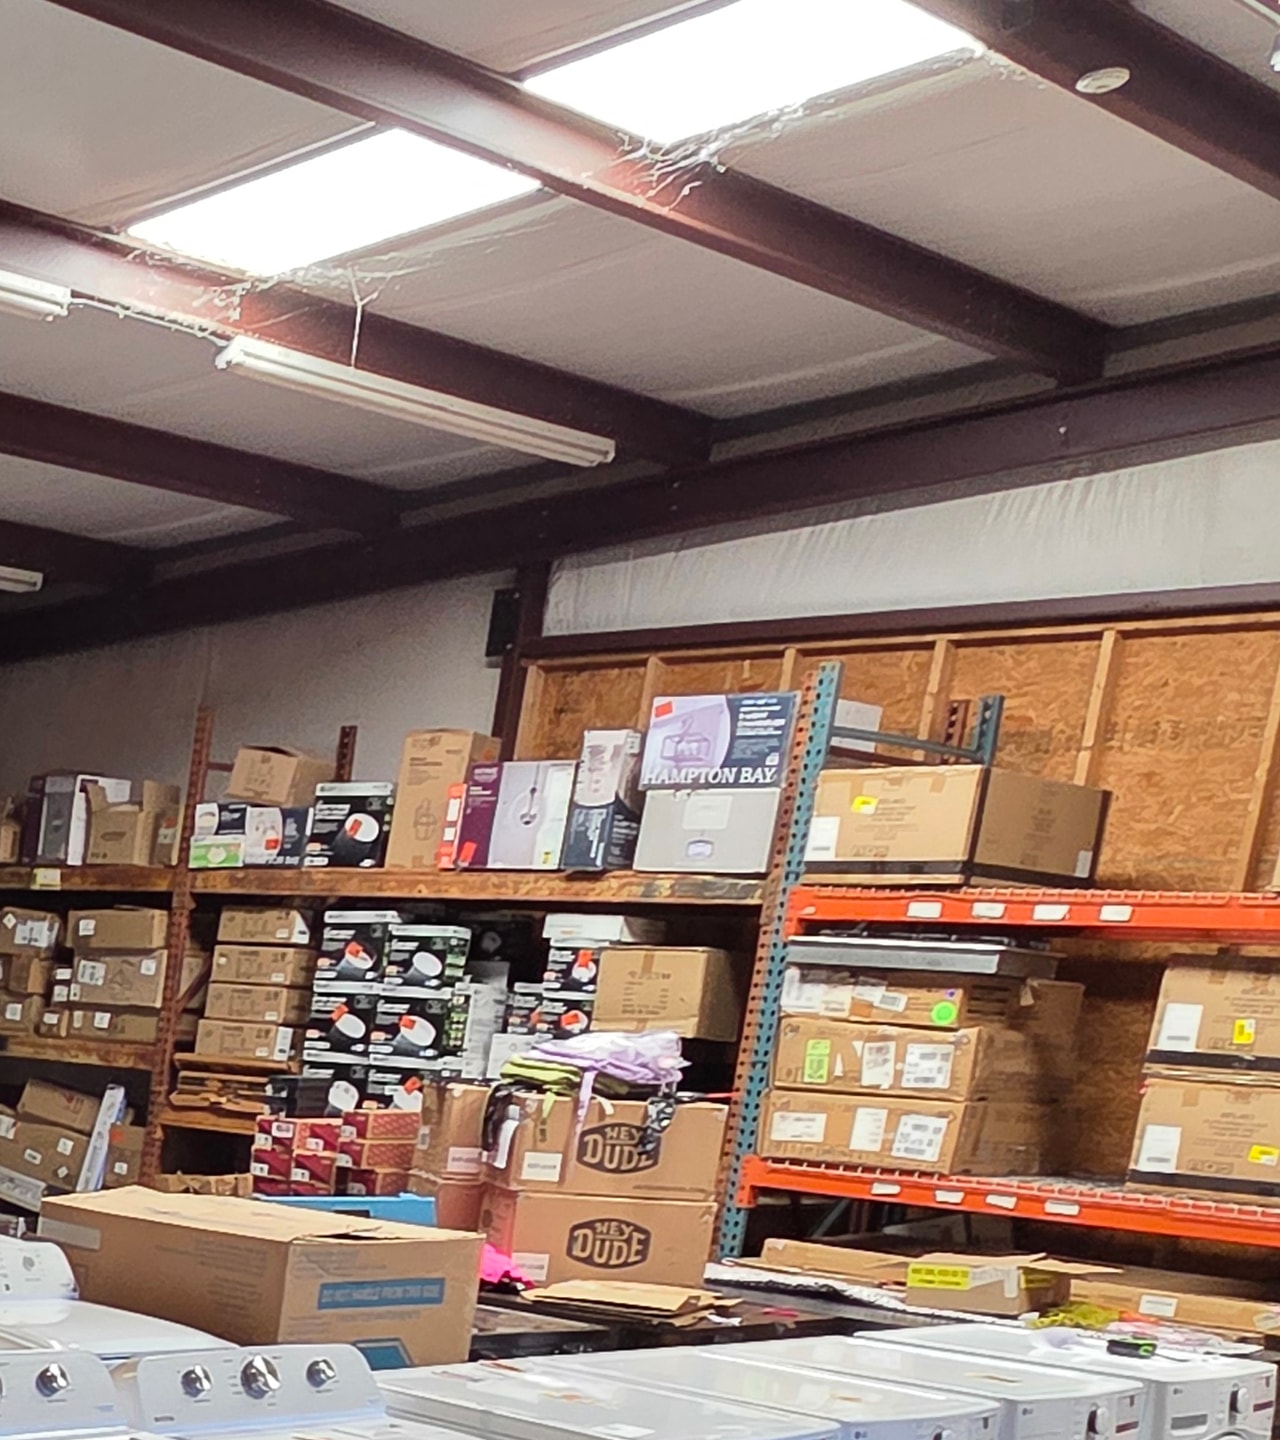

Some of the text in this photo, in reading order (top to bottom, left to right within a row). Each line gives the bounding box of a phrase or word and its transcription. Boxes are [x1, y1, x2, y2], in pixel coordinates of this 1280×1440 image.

[642, 766, 777, 785] HAMPTON BAY
[595, 1221, 634, 1239] HEY
[572, 1229, 647, 1266] DUDE
